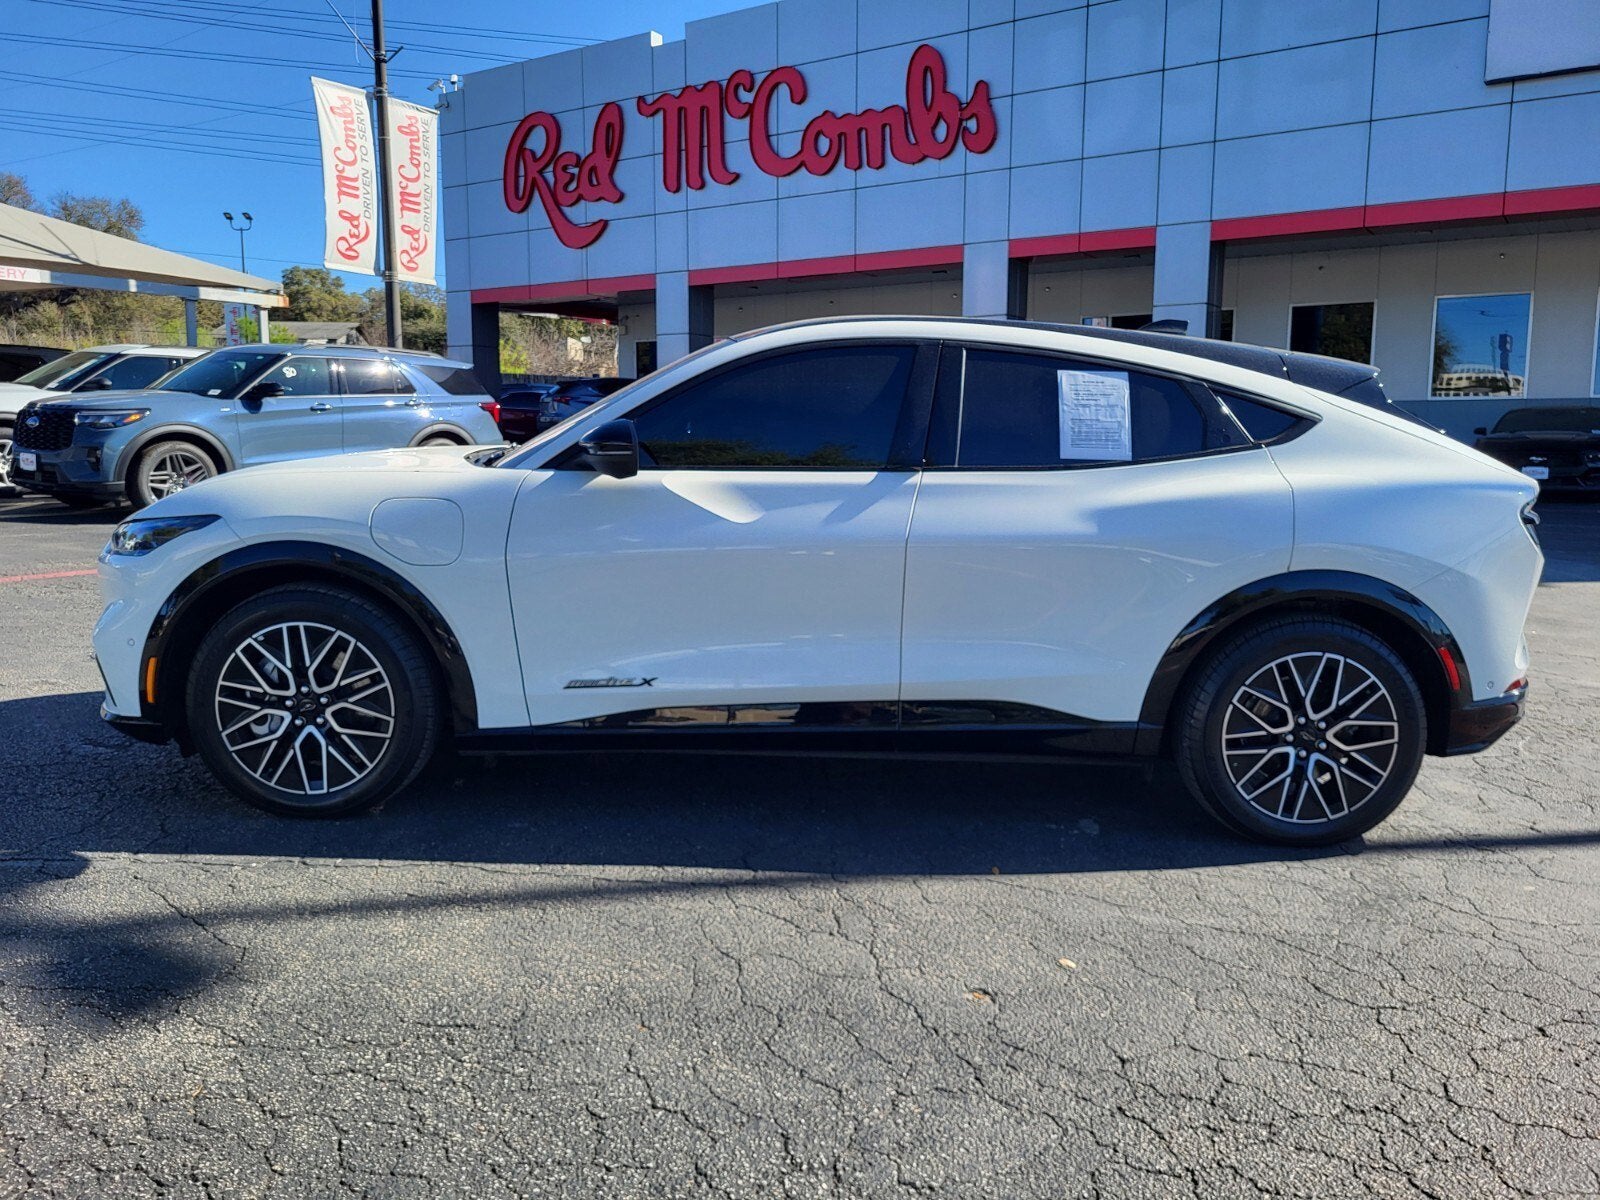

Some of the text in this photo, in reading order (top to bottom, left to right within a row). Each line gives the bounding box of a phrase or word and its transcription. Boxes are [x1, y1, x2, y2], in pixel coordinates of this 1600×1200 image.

[329, 95, 370, 261] Red McCombs
[354, 98, 371, 220] DRIVEN TO SERVE
[396, 114, 428, 272] Red McCombs
[420, 117, 433, 233] DRIVEN TO SERVE
[503, 44, 997, 250] Red McCombs
